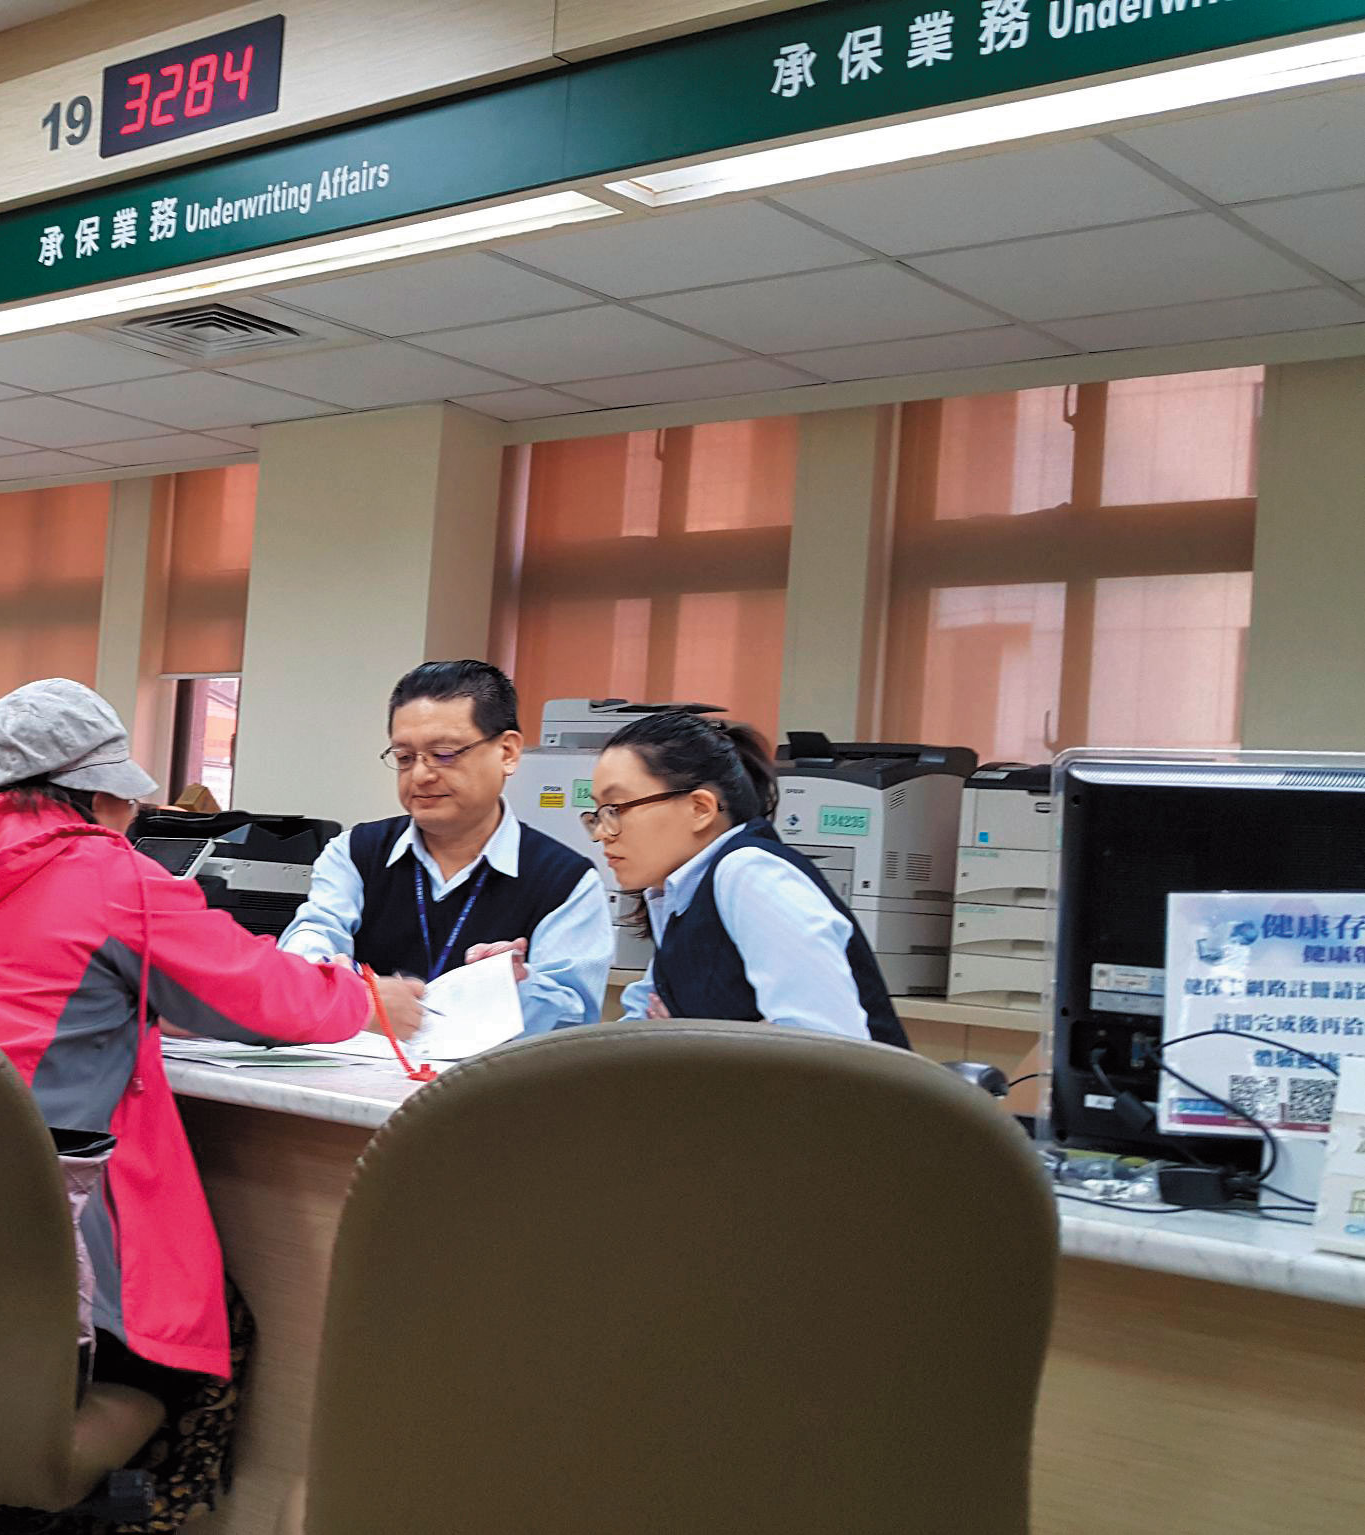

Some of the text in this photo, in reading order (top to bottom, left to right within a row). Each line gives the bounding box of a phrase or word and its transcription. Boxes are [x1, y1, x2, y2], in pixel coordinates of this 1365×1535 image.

[119, 44, 255, 136] 3284
[770, 0, 1031, 97] 承保業務
[41, 95, 92, 152] 19
[37, 160, 391, 267] 承保業務 Underwriting Affairs
